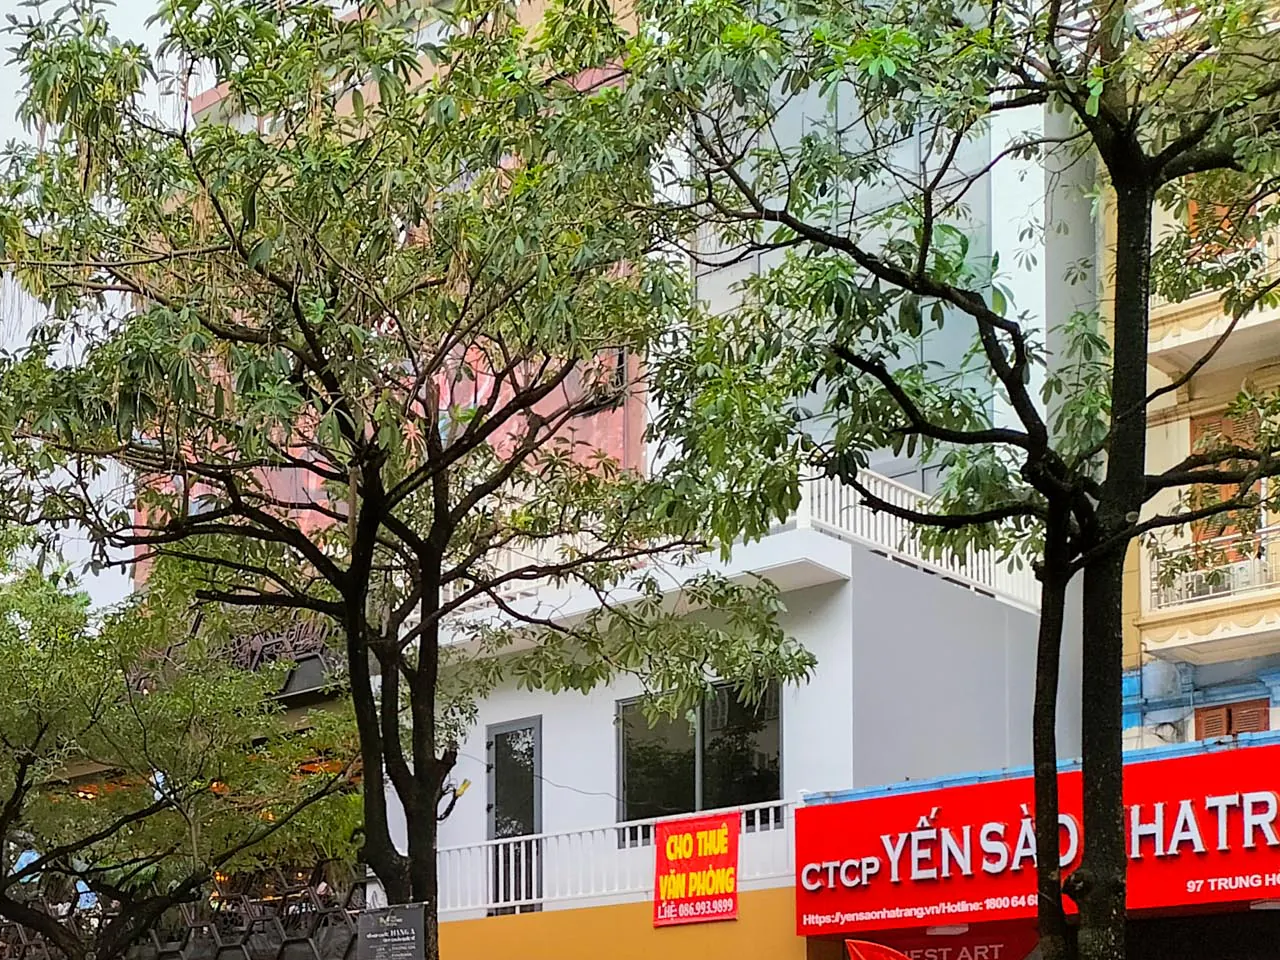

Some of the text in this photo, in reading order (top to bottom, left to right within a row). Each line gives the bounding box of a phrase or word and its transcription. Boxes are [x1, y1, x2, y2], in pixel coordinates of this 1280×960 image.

[666, 822, 728, 861] CHO THUÊ
[801, 856, 881, 891] CTCP
[880, 807, 973, 883] YẾN
[1125, 790, 1280, 859] HATR
[659, 864, 735, 900] VĂN PHÒNG
[1186, 868, 1280, 893] 97 TRUNG H
[678, 898, 734, 917] 086.993.9899
[984, 896, 1011, 909] 1800
[1011, 895, 1026, 908] 64
[956, 944, 1004, 960] ART
